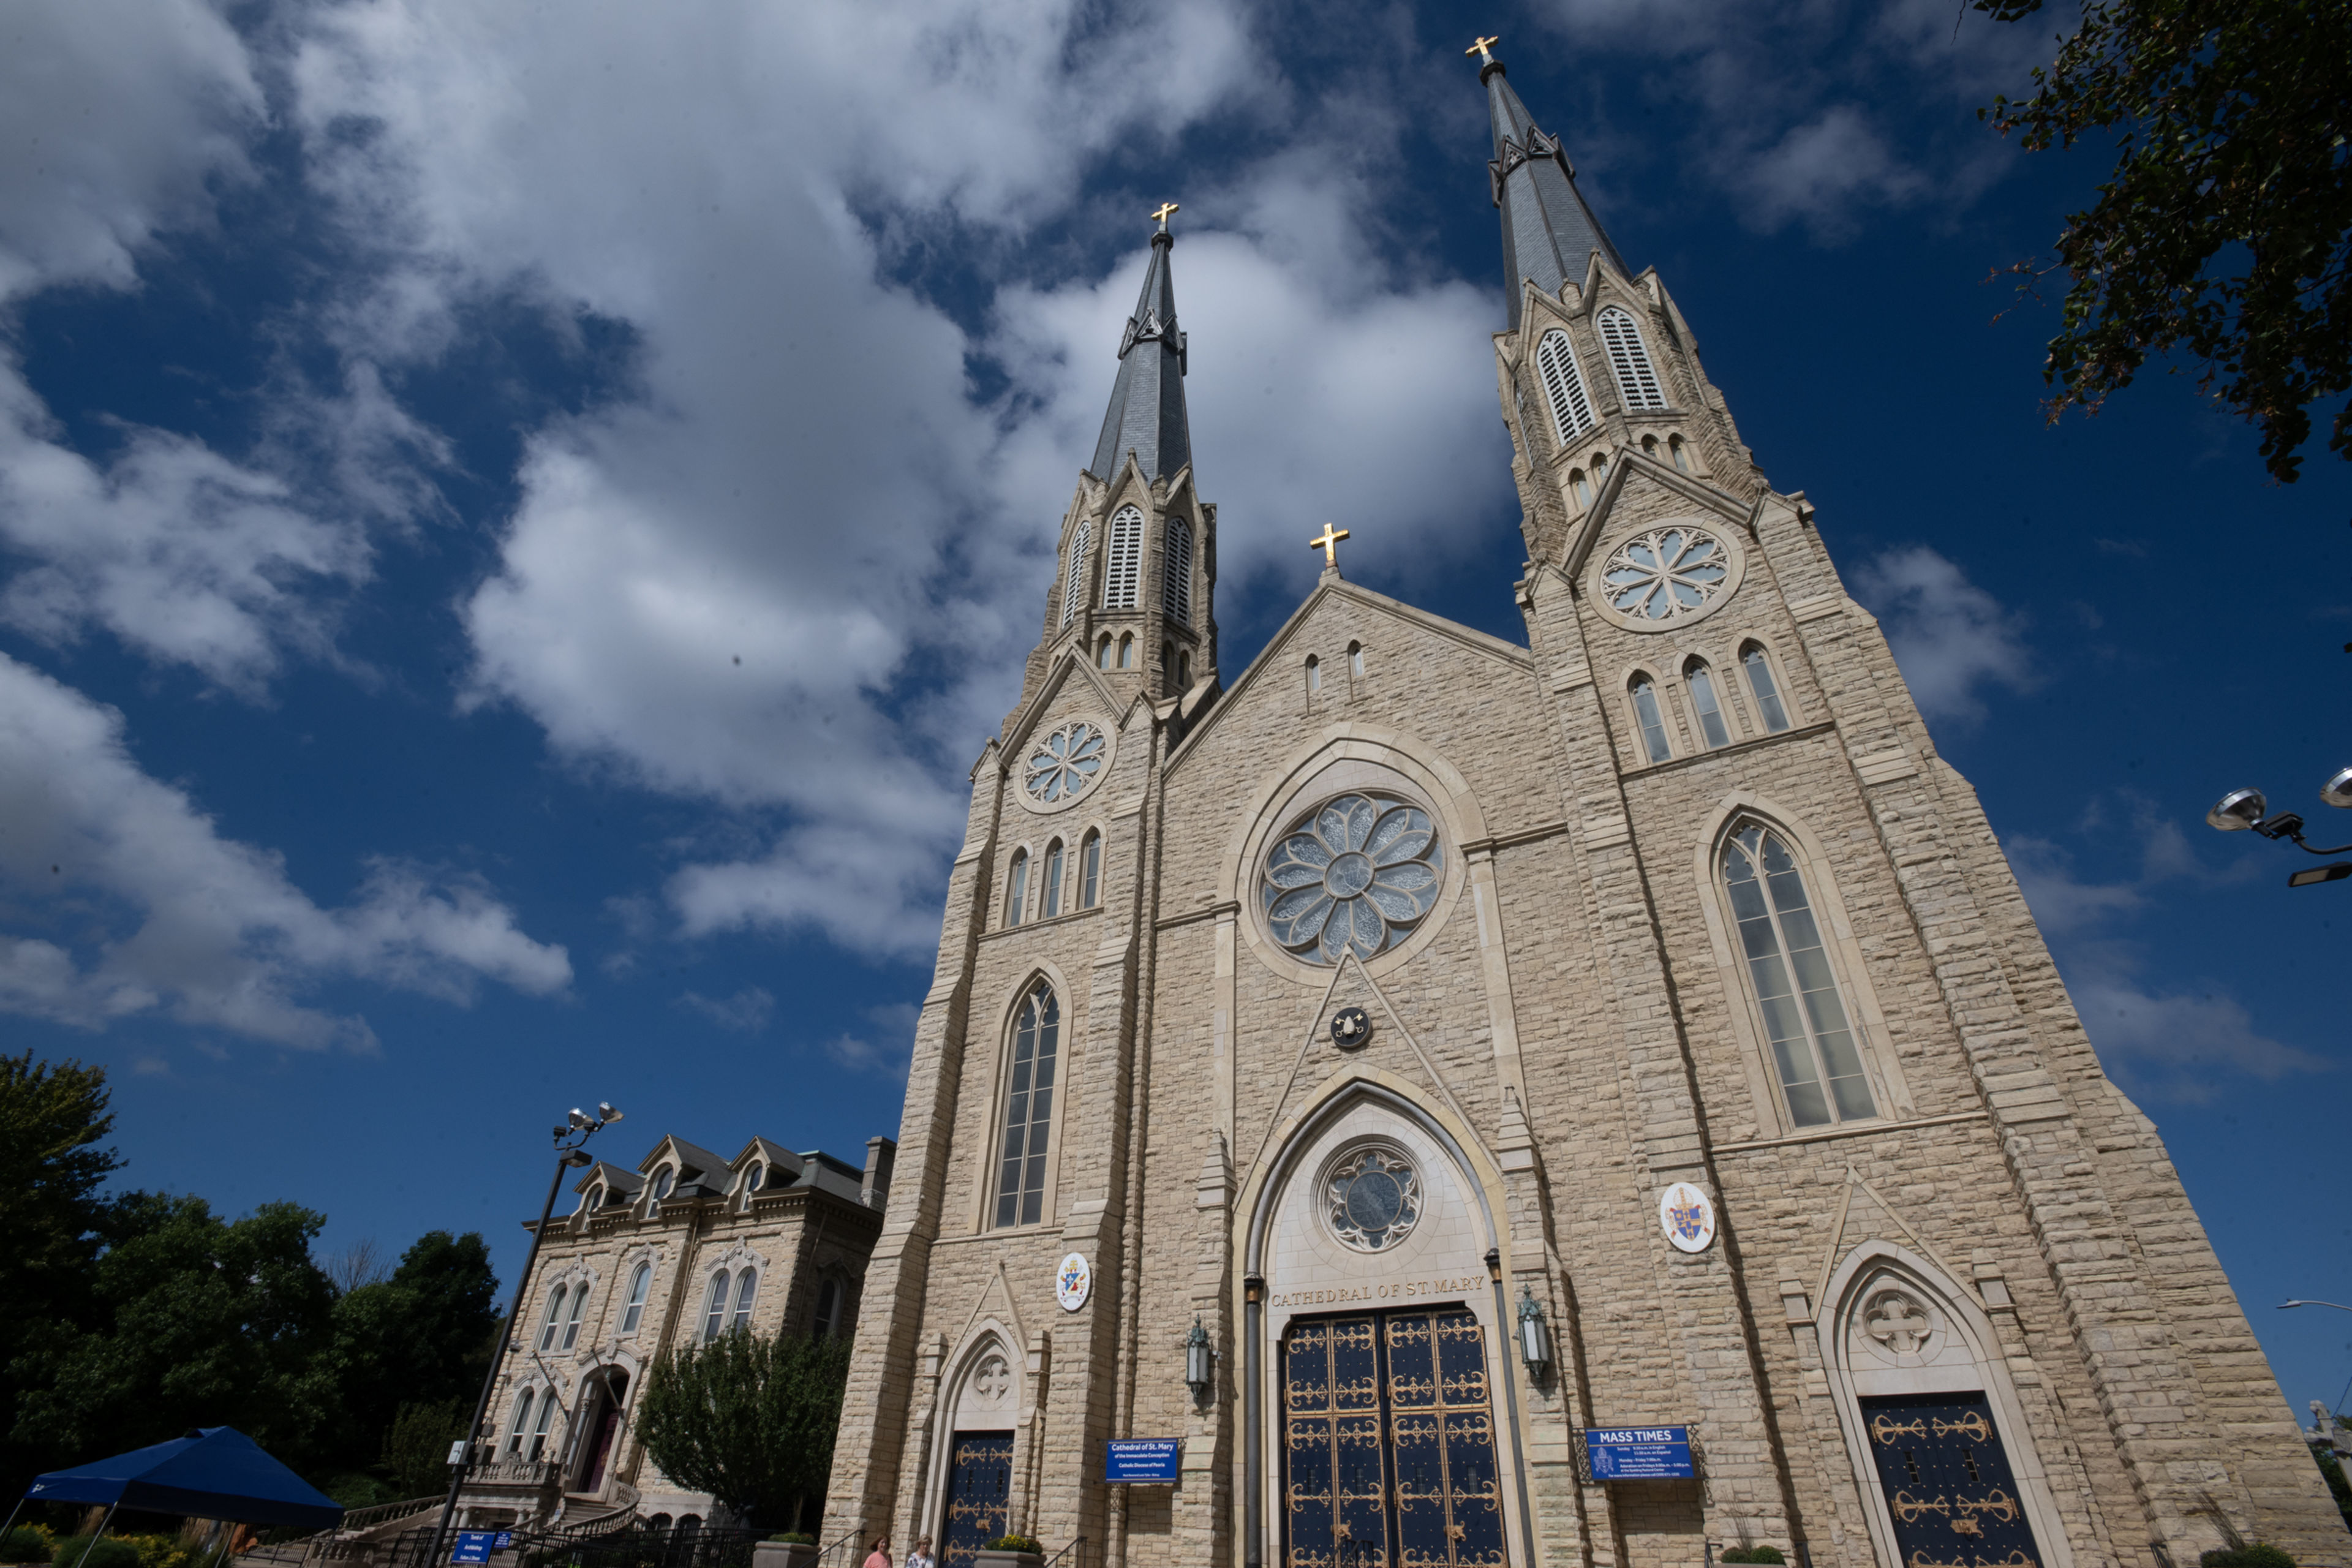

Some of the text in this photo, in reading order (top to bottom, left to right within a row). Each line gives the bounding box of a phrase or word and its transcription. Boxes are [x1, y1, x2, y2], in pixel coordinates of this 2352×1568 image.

[1271, 1275, 1484, 1306] CATHEDRAL OF ST. MARY
[1600, 1430, 1672, 1443] MASS TIMES
[1158, 1443, 1174, 1452] Mary
